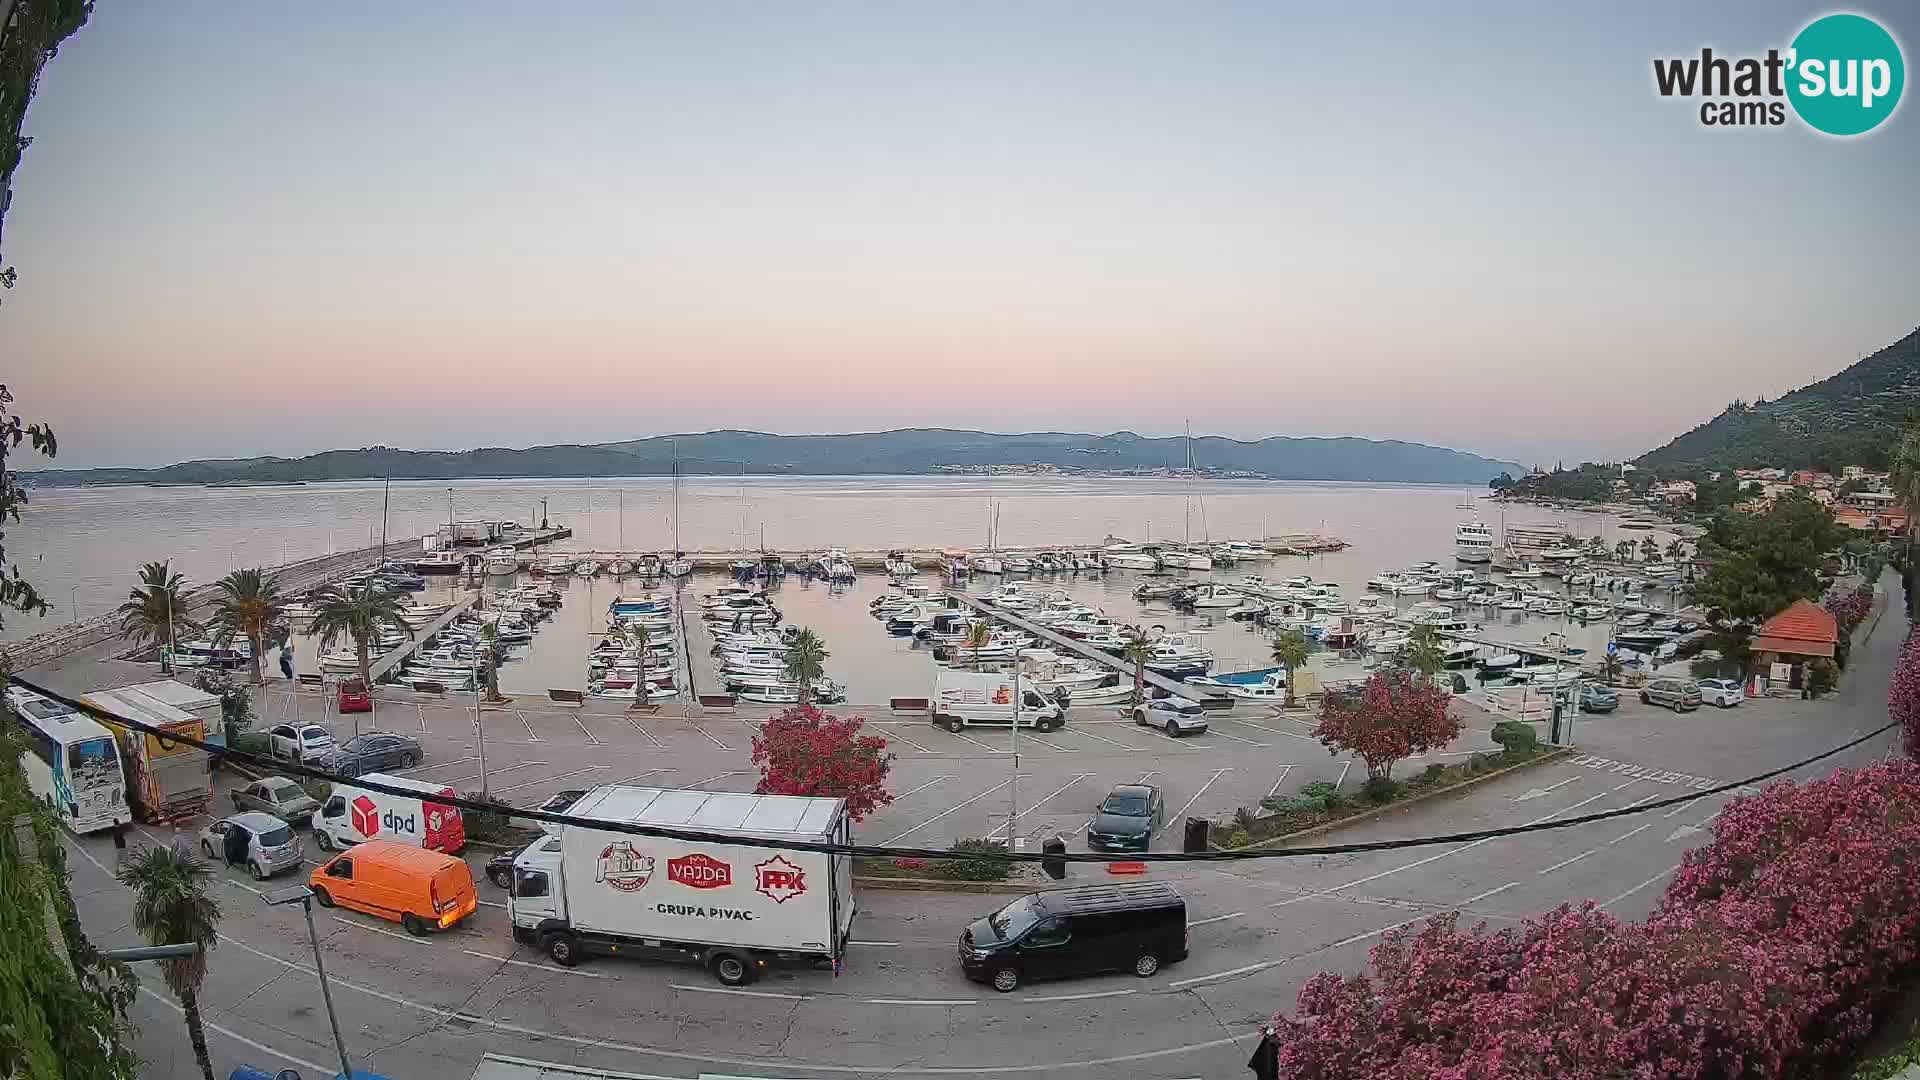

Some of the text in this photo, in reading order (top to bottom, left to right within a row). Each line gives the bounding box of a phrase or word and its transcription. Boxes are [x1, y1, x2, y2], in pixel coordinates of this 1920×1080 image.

[384, 809, 415, 834] dpd
[671, 863, 727, 881] VAJDA
[763, 870, 808, 890] PPK
[656, 903, 753, 921] GRUPA PIVAC
